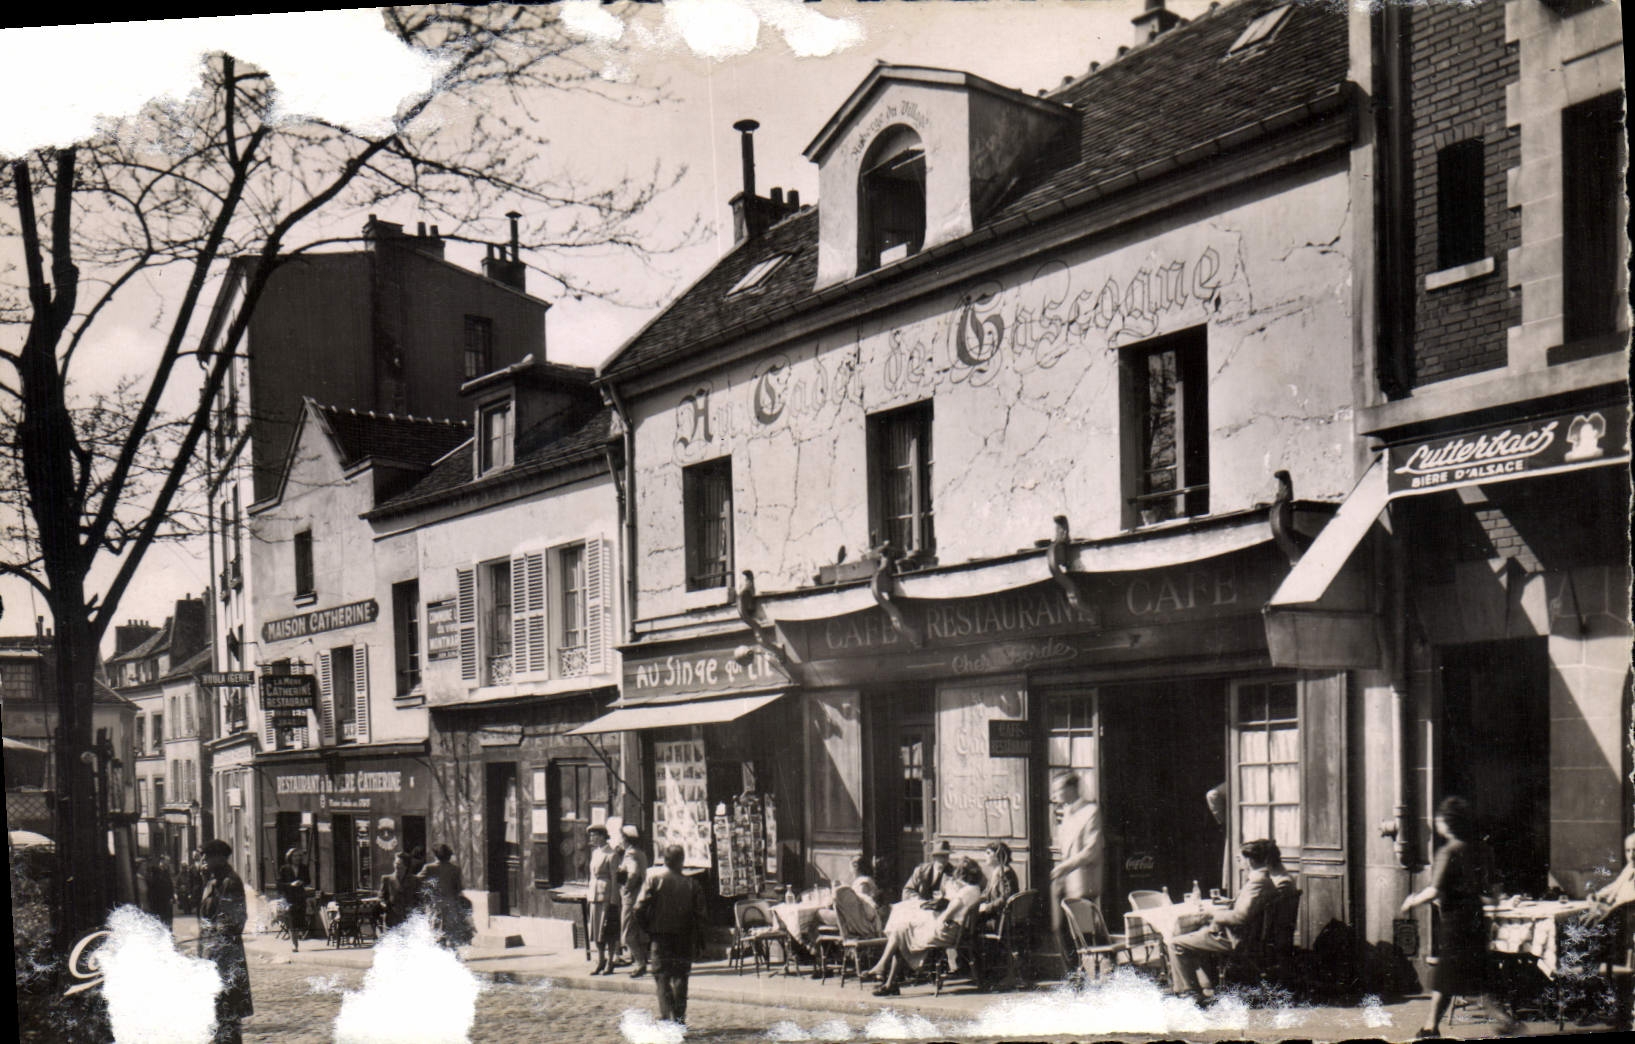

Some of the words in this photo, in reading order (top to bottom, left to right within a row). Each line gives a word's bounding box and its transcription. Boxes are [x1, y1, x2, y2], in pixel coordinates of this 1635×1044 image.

[946, 247, 1223, 383] Gascogne
[1393, 420, 1559, 475] Lutterbach
[1454, 461, 1524, 480] D'ALSACE
[267, 614, 306, 639] MAISON
[309, 600, 372, 632] CATHERINE
[266, 681, 312, 697] CATHERINE
[266, 697, 313, 707] RESTAURANT
[276, 774, 320, 794] RESTAURANT
[357, 770, 401, 793] CATHERINE
